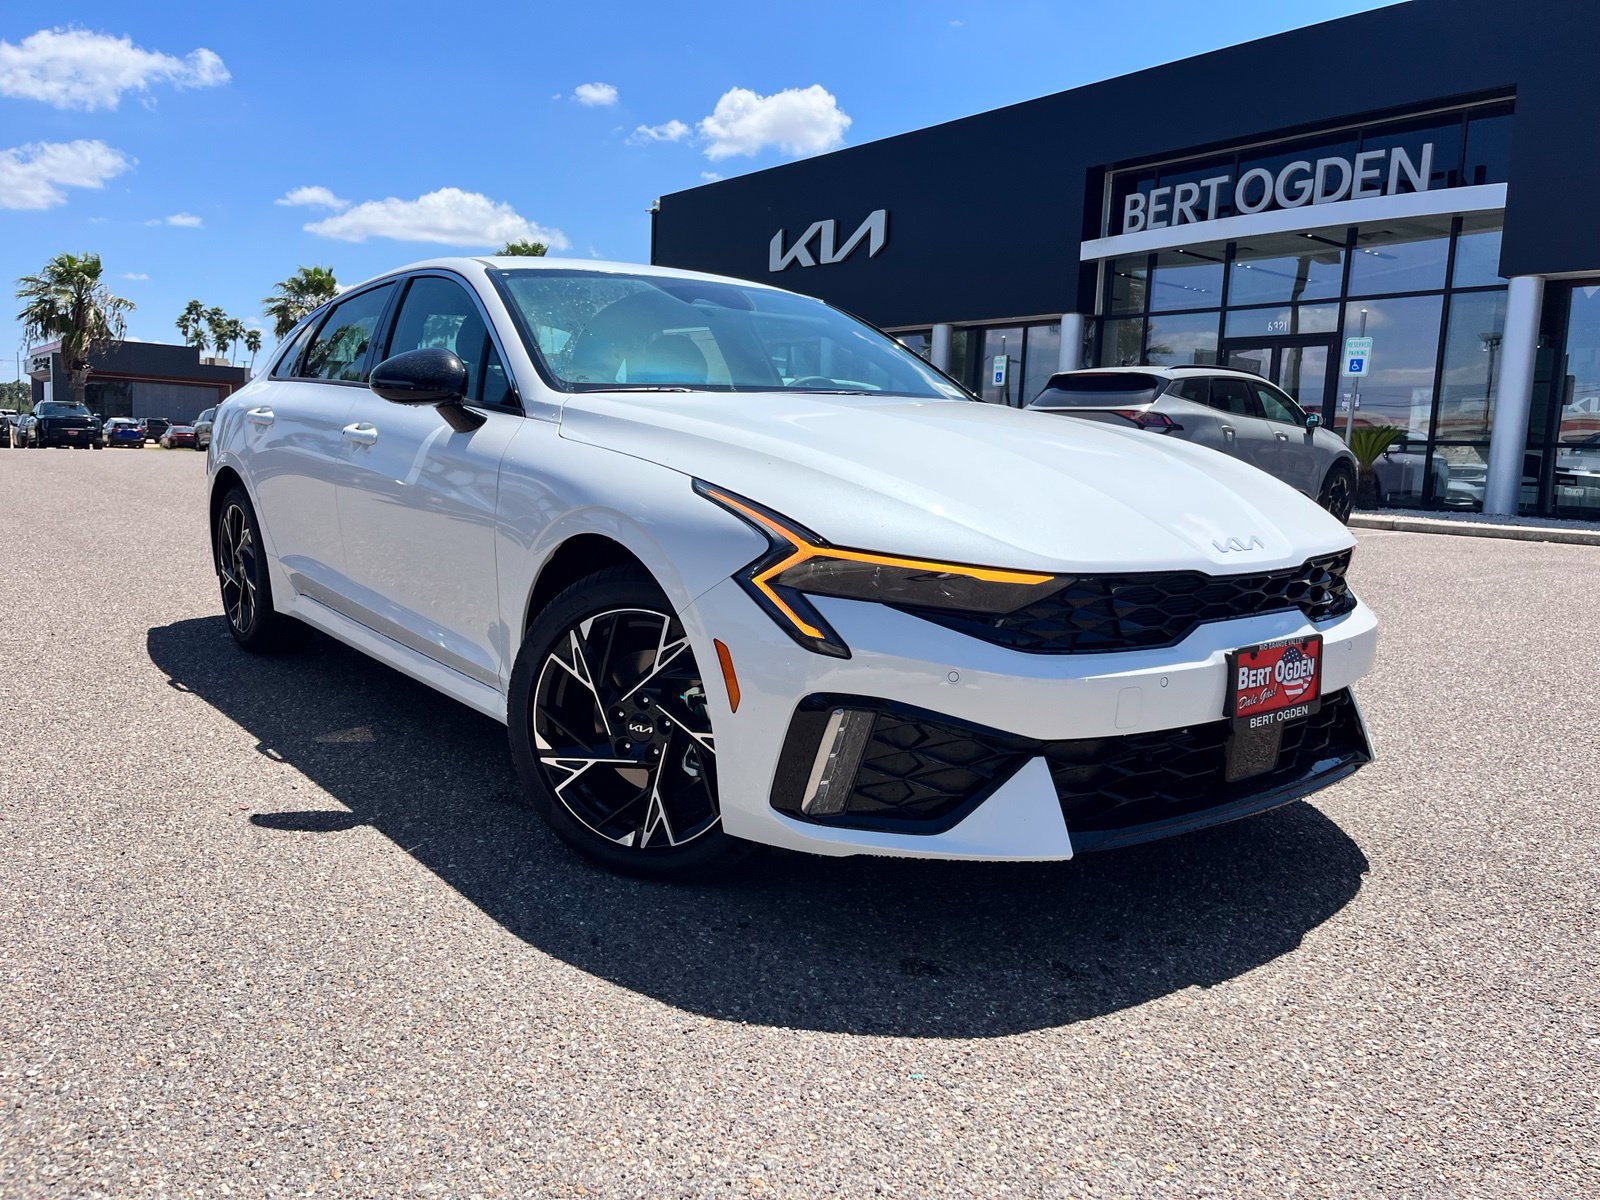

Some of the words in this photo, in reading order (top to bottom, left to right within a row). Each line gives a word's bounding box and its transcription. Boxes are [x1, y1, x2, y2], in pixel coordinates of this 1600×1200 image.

[1122, 174, 1231, 234] BERT
[1234, 143, 1434, 214] OGDEN
[769, 209, 888, 272] KIA
[1212, 535, 1265, 553] KIA
[1238, 666, 1272, 690] BERT
[1274, 658, 1315, 683] OGDEN
[1239, 694, 1257, 710] Dale
[629, 723, 653, 734] KIA
[1249, 713, 1275, 729] BERT
[1276, 705, 1308, 722] OGDEN
